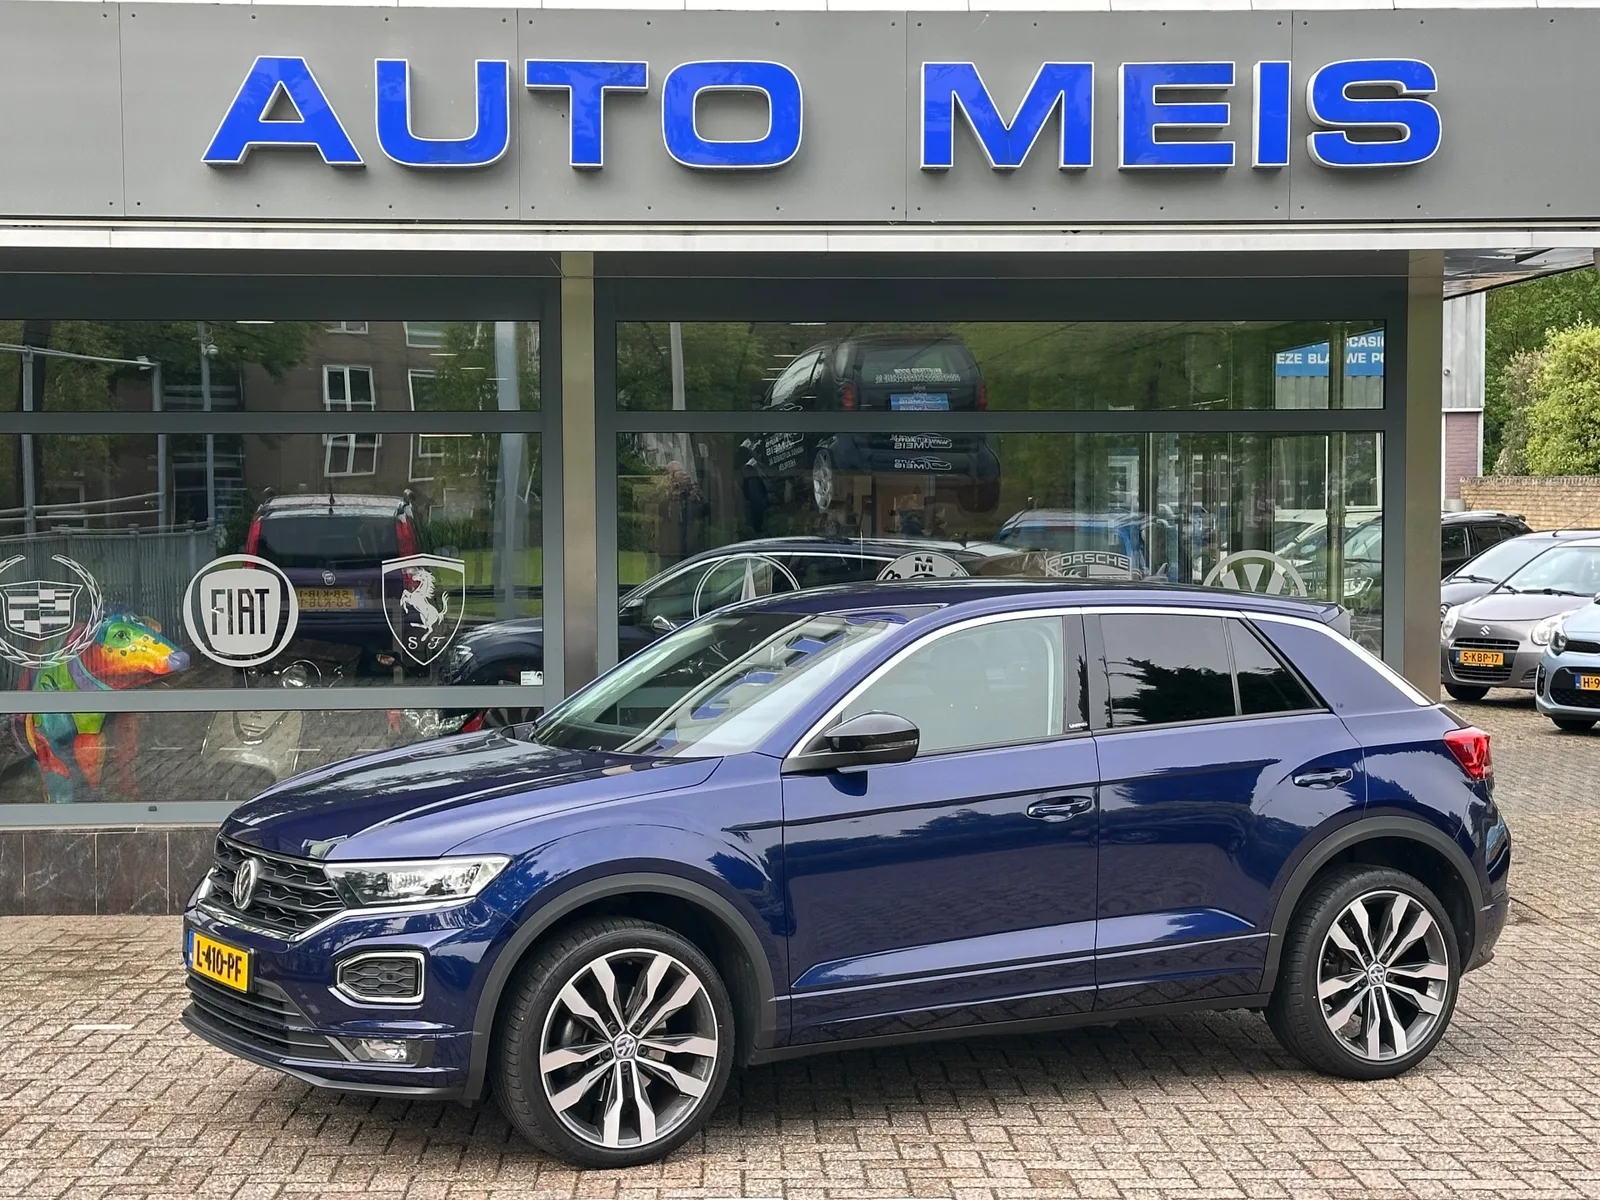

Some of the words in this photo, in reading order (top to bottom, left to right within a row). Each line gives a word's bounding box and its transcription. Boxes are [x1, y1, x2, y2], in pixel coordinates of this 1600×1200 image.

[201, 56, 804, 168] AUTO
[920, 58, 1443, 170] MEIS
[1346, 336, 1384, 348] CASI
[1048, 553, 1130, 572] PORSCHE
[211, 588, 270, 635] FIAT
[408, 636, 418, 650] S
[1463, 652, 1500, 663] 5-KBP-17
[196, 940, 243, 982] L-410-PF
